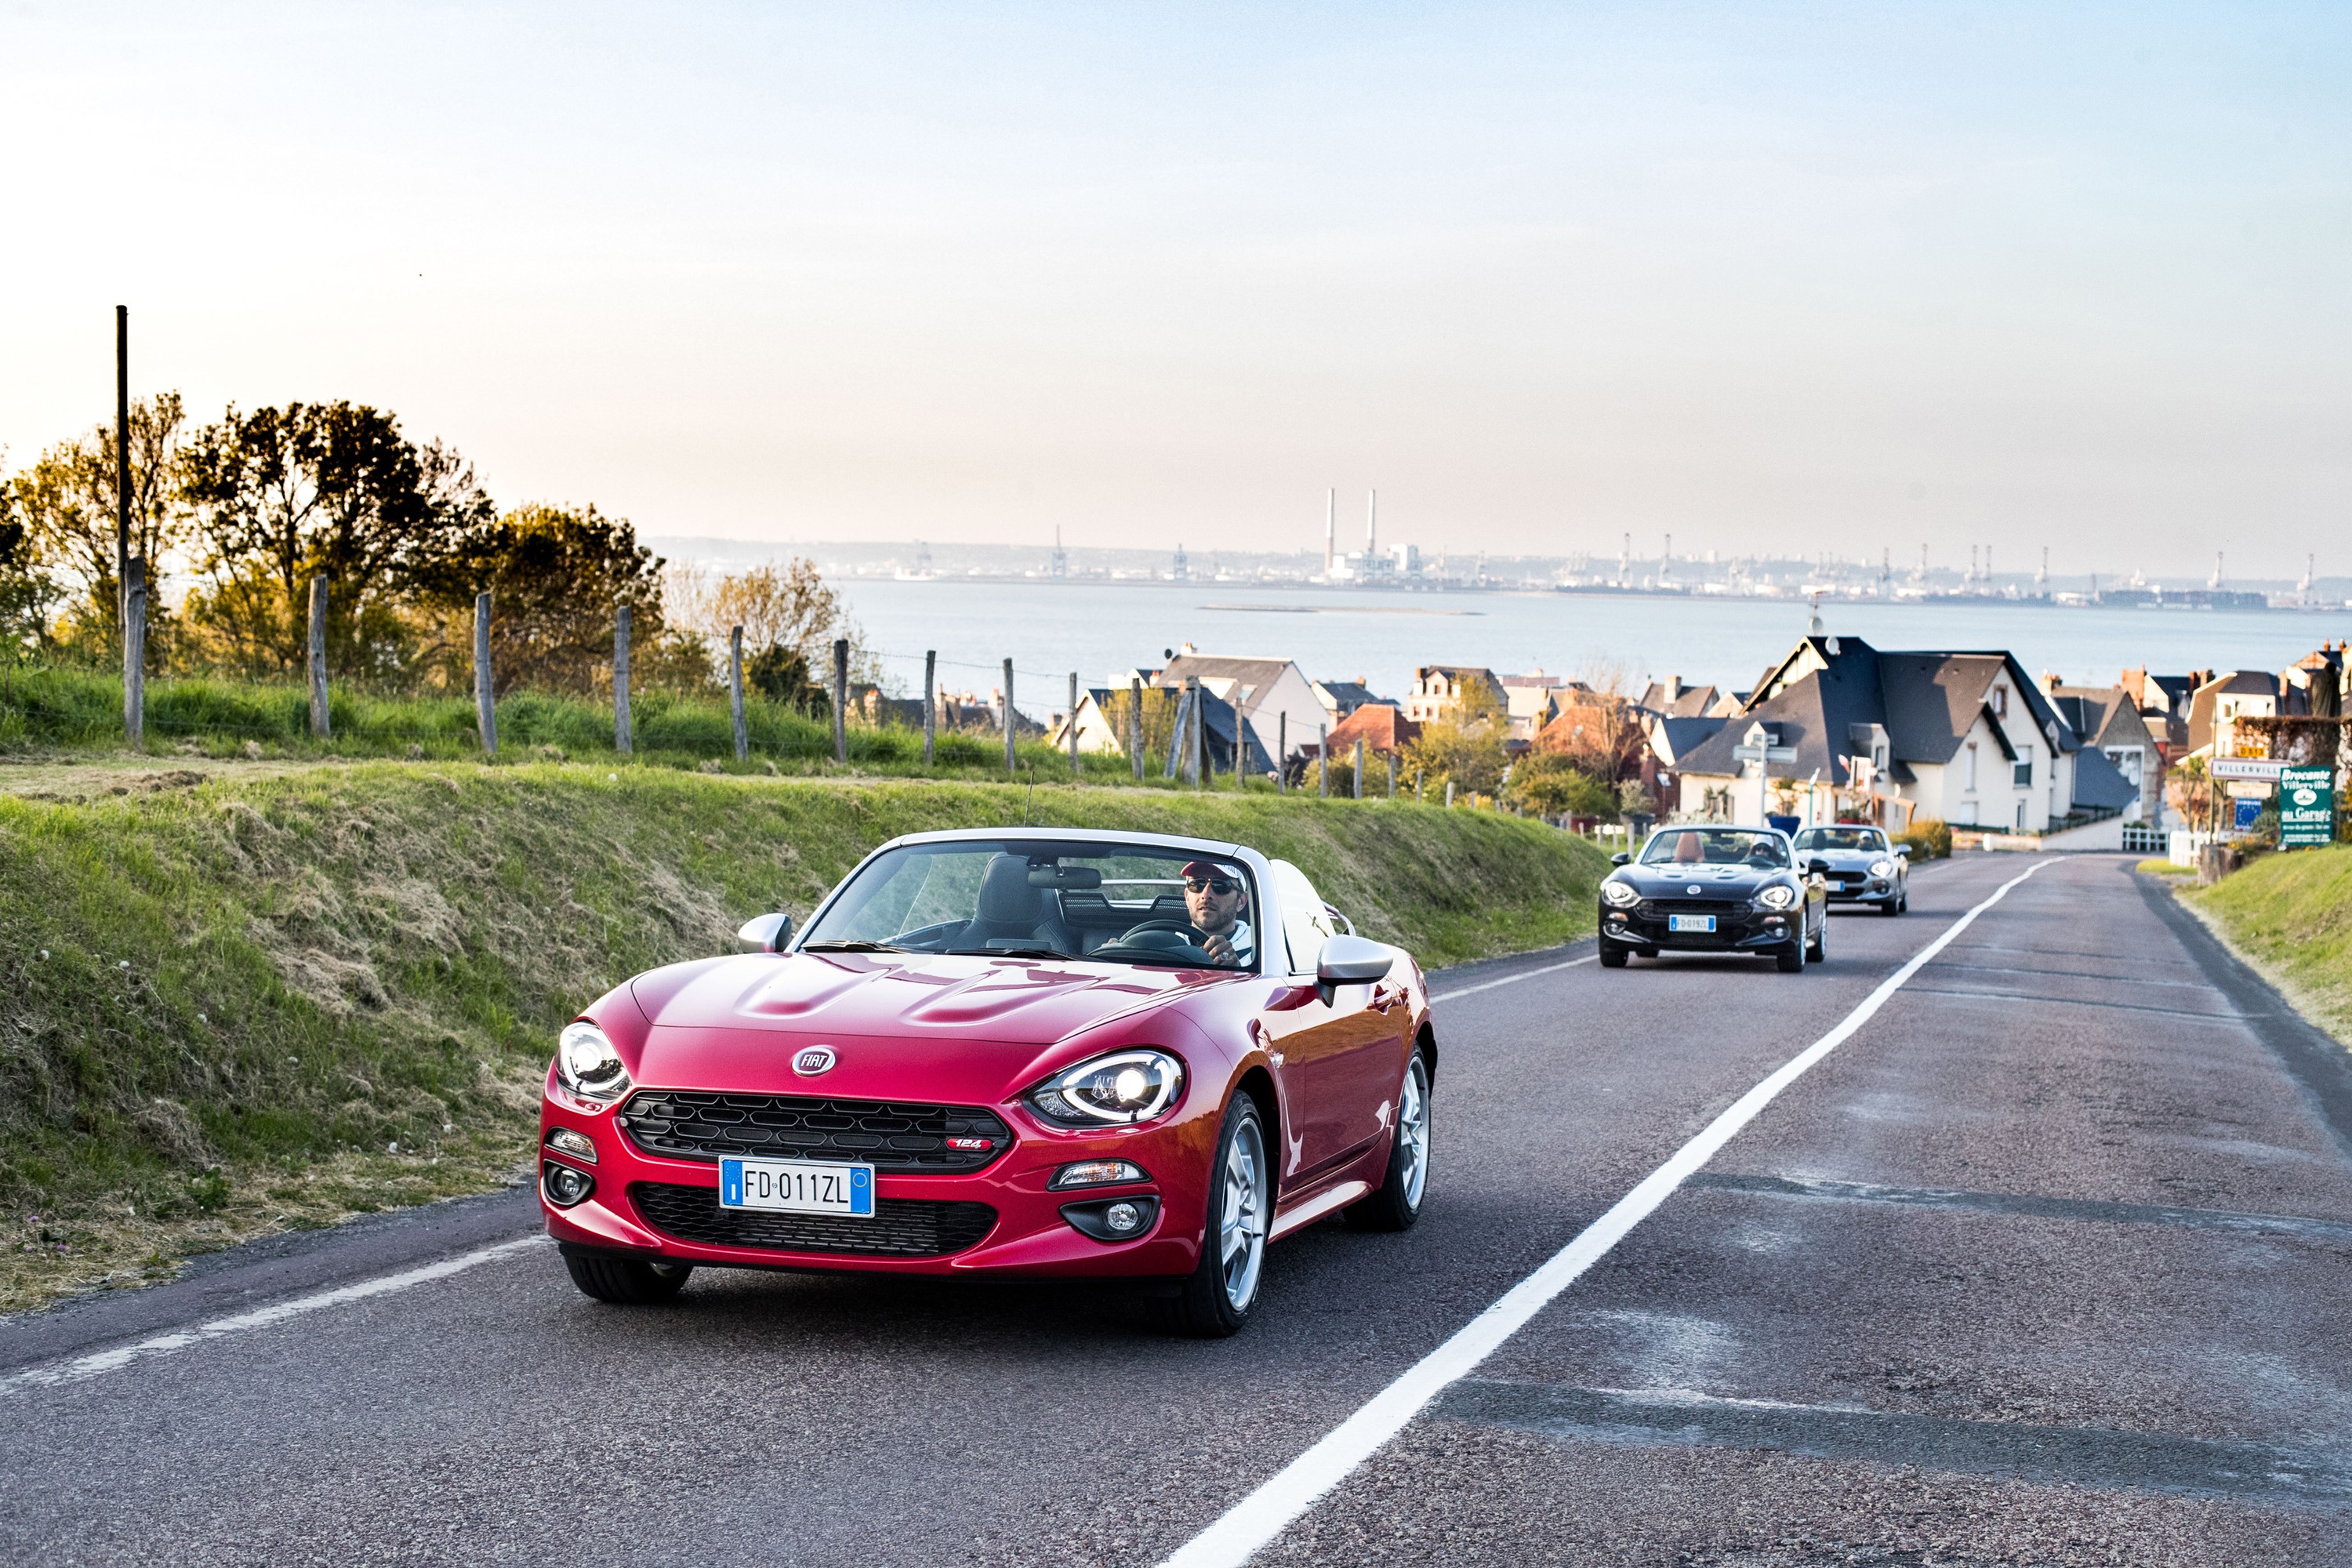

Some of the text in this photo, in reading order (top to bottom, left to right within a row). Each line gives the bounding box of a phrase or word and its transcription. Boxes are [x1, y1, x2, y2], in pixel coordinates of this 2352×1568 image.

[2218, 764, 2278, 774] VILLERVILL
[2282, 769, 2331, 781] Brocante
[2282, 780, 2331, 789] Villerville
[800, 1054, 828, 1068] FIAT
[953, 1138, 982, 1149] 124
